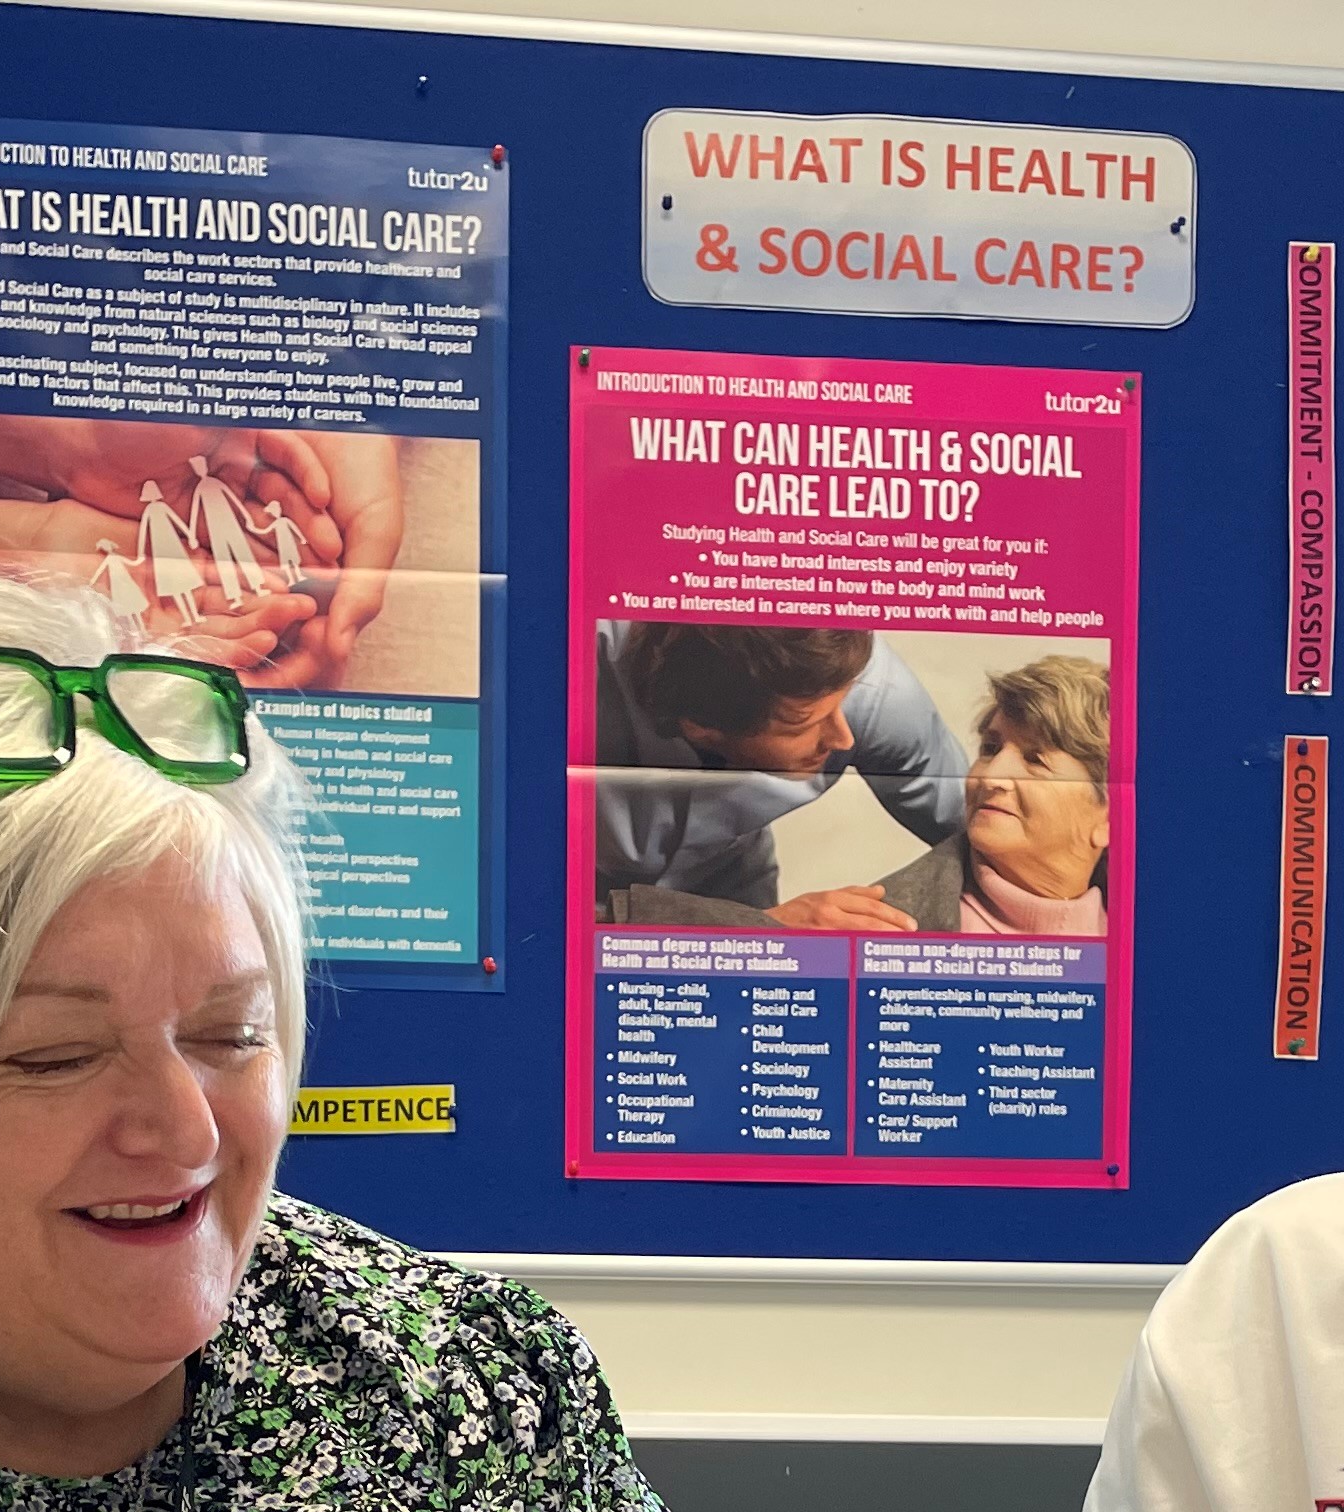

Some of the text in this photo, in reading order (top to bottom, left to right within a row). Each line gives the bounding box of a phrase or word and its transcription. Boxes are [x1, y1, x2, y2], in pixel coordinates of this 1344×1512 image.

[47, 144, 70, 167] TO
[72, 146, 132, 170] HEALTH
[134, 149, 168, 171] AND
[170, 151, 225, 175] SOCIAL
[227, 154, 268, 177] CARE
[684, 132, 1156, 203] WHAT IS HEALTH
[408, 168, 488, 192] tutor2u
[32, 190, 62, 233] IS
[69, 192, 188, 239] HEALTH
[194, 198, 261, 243] AND
[267, 202, 377, 250] SOCIAL
[383, 210, 481, 255] CARE?
[0, 240, 26, 256] and
[28, 241, 70, 258] Social
[71, 244, 104, 260] Care
[105, 246, 171, 265] describes
[172, 249, 195, 266] the
[196, 252, 232, 267] work
[233, 254, 283, 270] sectors
[284, 255, 312, 271] that
[313, 258, 363, 275] provide
[364, 260, 434, 278] healthcare
[436, 265, 461, 279] and
[695, 223, 1145, 293] & SOCIAL CARE?
[143, 267, 278, 287] social care services.
[597, 371, 913, 405] INTRODUCTION TO HEALTH AND SOCIAL CARE
[1045, 391, 1121, 415] tutor2u
[630, 417, 1082, 479] WHAT CAN HEALTH & SOCIAL
[735, 471, 980, 523] CARE LEAD TO?
[662, 523, 1049, 556] Studying Health and Social Care will be great for you if:
[711, 550, 1019, 581] You have broad interests and enjoy variety
[682, 571, 1046, 601] You are interested in how the body and mind work
[1298, 489, 1324, 690] COMPASSION
[621, 591, 1104, 628] You are interested in careers where you work with and help people
[1285, 764, 1316, 1030] COMMUNICATION
[602, 935, 785, 959] Common degree subjects for
[864, 941, 1082, 962] Common non-degree next steps for
[602, 953, 800, 972] Health and Social Care students
[863, 957, 1063, 977] Health and Social Care Students
[617, 1050, 677, 1067] Midwifery
[751, 1061, 810, 1079] Sociology
[752, 1082, 820, 1100] Psychology
[293, 1097, 450, 1122] MPETENCE
[751, 1104, 823, 1121] Criminology
[617, 1130, 676, 1144] Education
